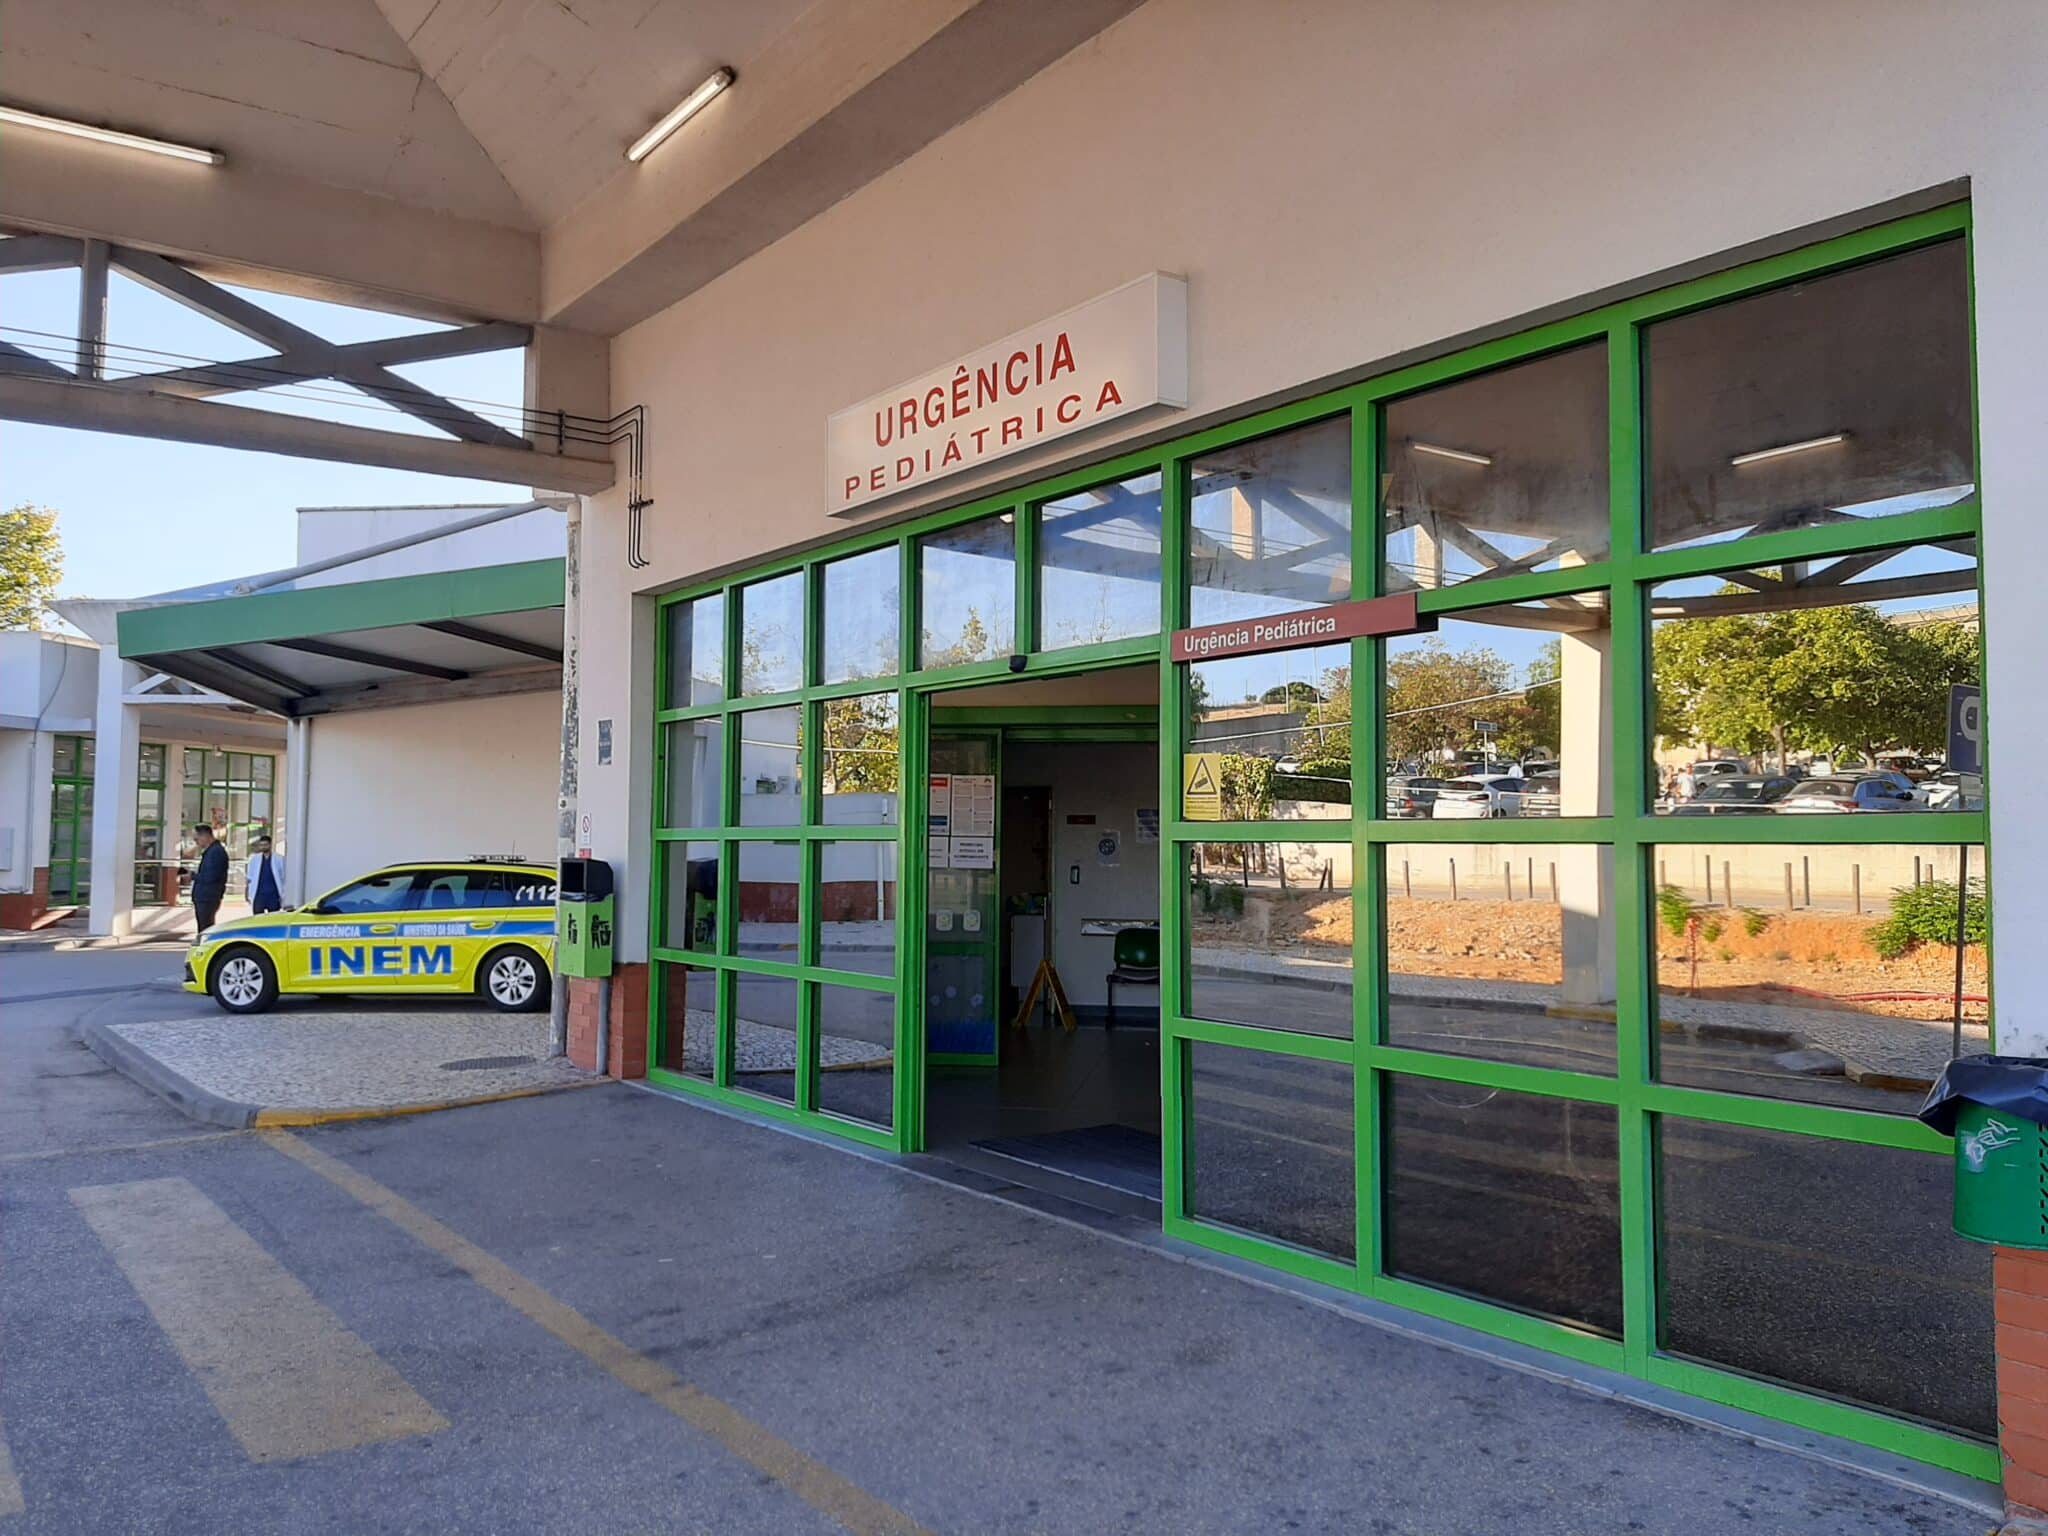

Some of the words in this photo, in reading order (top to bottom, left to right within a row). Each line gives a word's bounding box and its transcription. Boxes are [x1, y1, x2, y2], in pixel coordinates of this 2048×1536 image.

[875, 332, 1076, 447] URGÊNCIA
[845, 380, 1123, 500] PEDIÁTRICA
[1184, 628, 1249, 656] Urgência
[1254, 616, 1336, 644] Pediátrica
[300, 924, 361, 938] EMERGÊNCIA
[310, 945, 453, 976] INEM
